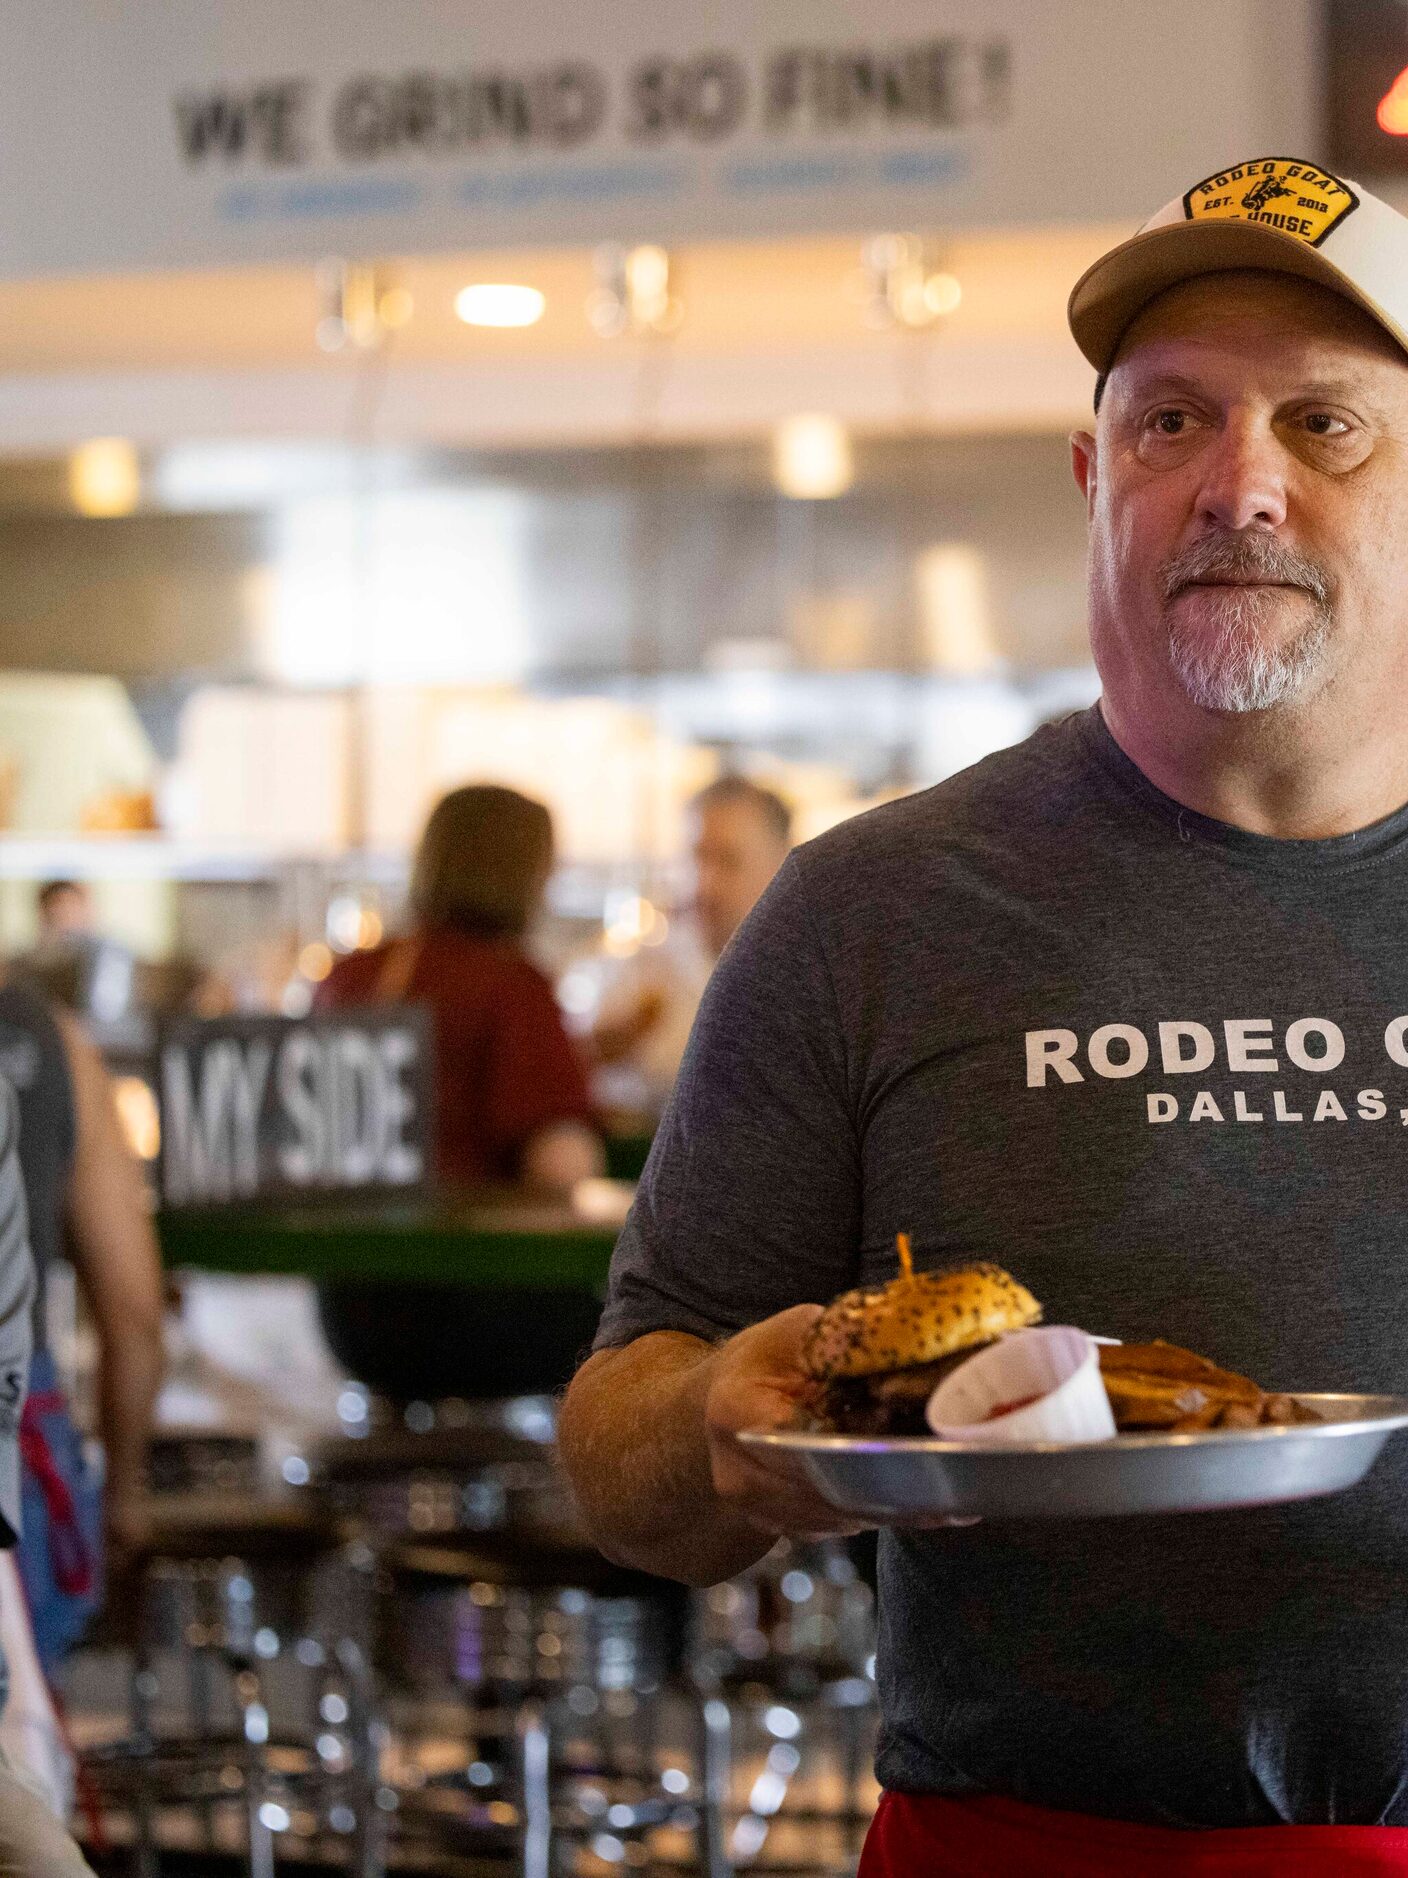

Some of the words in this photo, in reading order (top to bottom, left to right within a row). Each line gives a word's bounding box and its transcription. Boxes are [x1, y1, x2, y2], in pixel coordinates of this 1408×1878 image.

[174, 76, 312, 168] WE
[332, 61, 604, 162] GRIND
[625, 49, 747, 146] SO
[1200, 162, 1275, 196] RODEO
[1286, 164, 1346, 197] GOAT
[1203, 196, 1235, 212] EST.
[1024, 1017, 1346, 1088] RODEO
[162, 1036, 271, 1203] MY
[276, 1029, 424, 1186] SIDE
